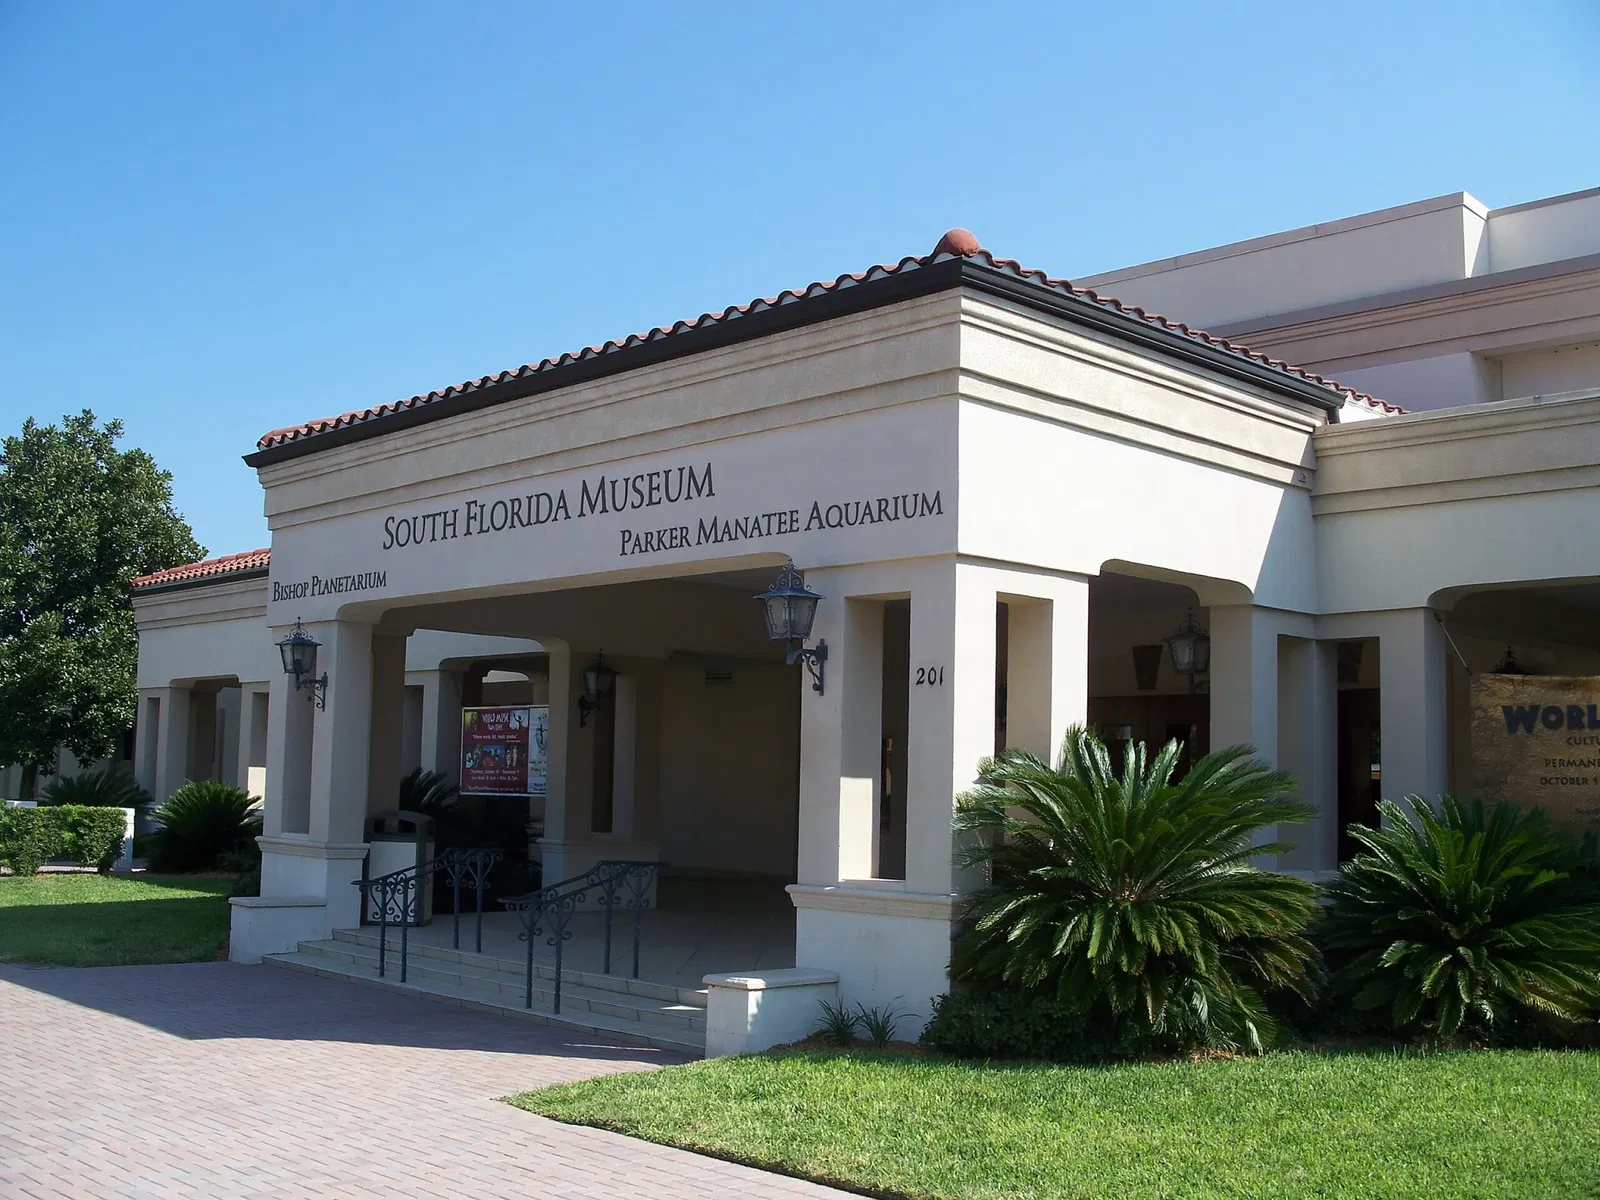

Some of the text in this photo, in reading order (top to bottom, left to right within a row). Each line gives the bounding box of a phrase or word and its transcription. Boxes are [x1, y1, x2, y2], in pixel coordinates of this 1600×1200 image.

[383, 462, 716, 549] SOUTH FLORIDA MUSEUM
[619, 490, 944, 556] PARKER MANATEE AQUARIUM
[272, 571, 387, 602] BISHOP PLANETARIUM
[916, 666, 945, 686] 201
[1539, 776, 1588, 786] OCTOBER
